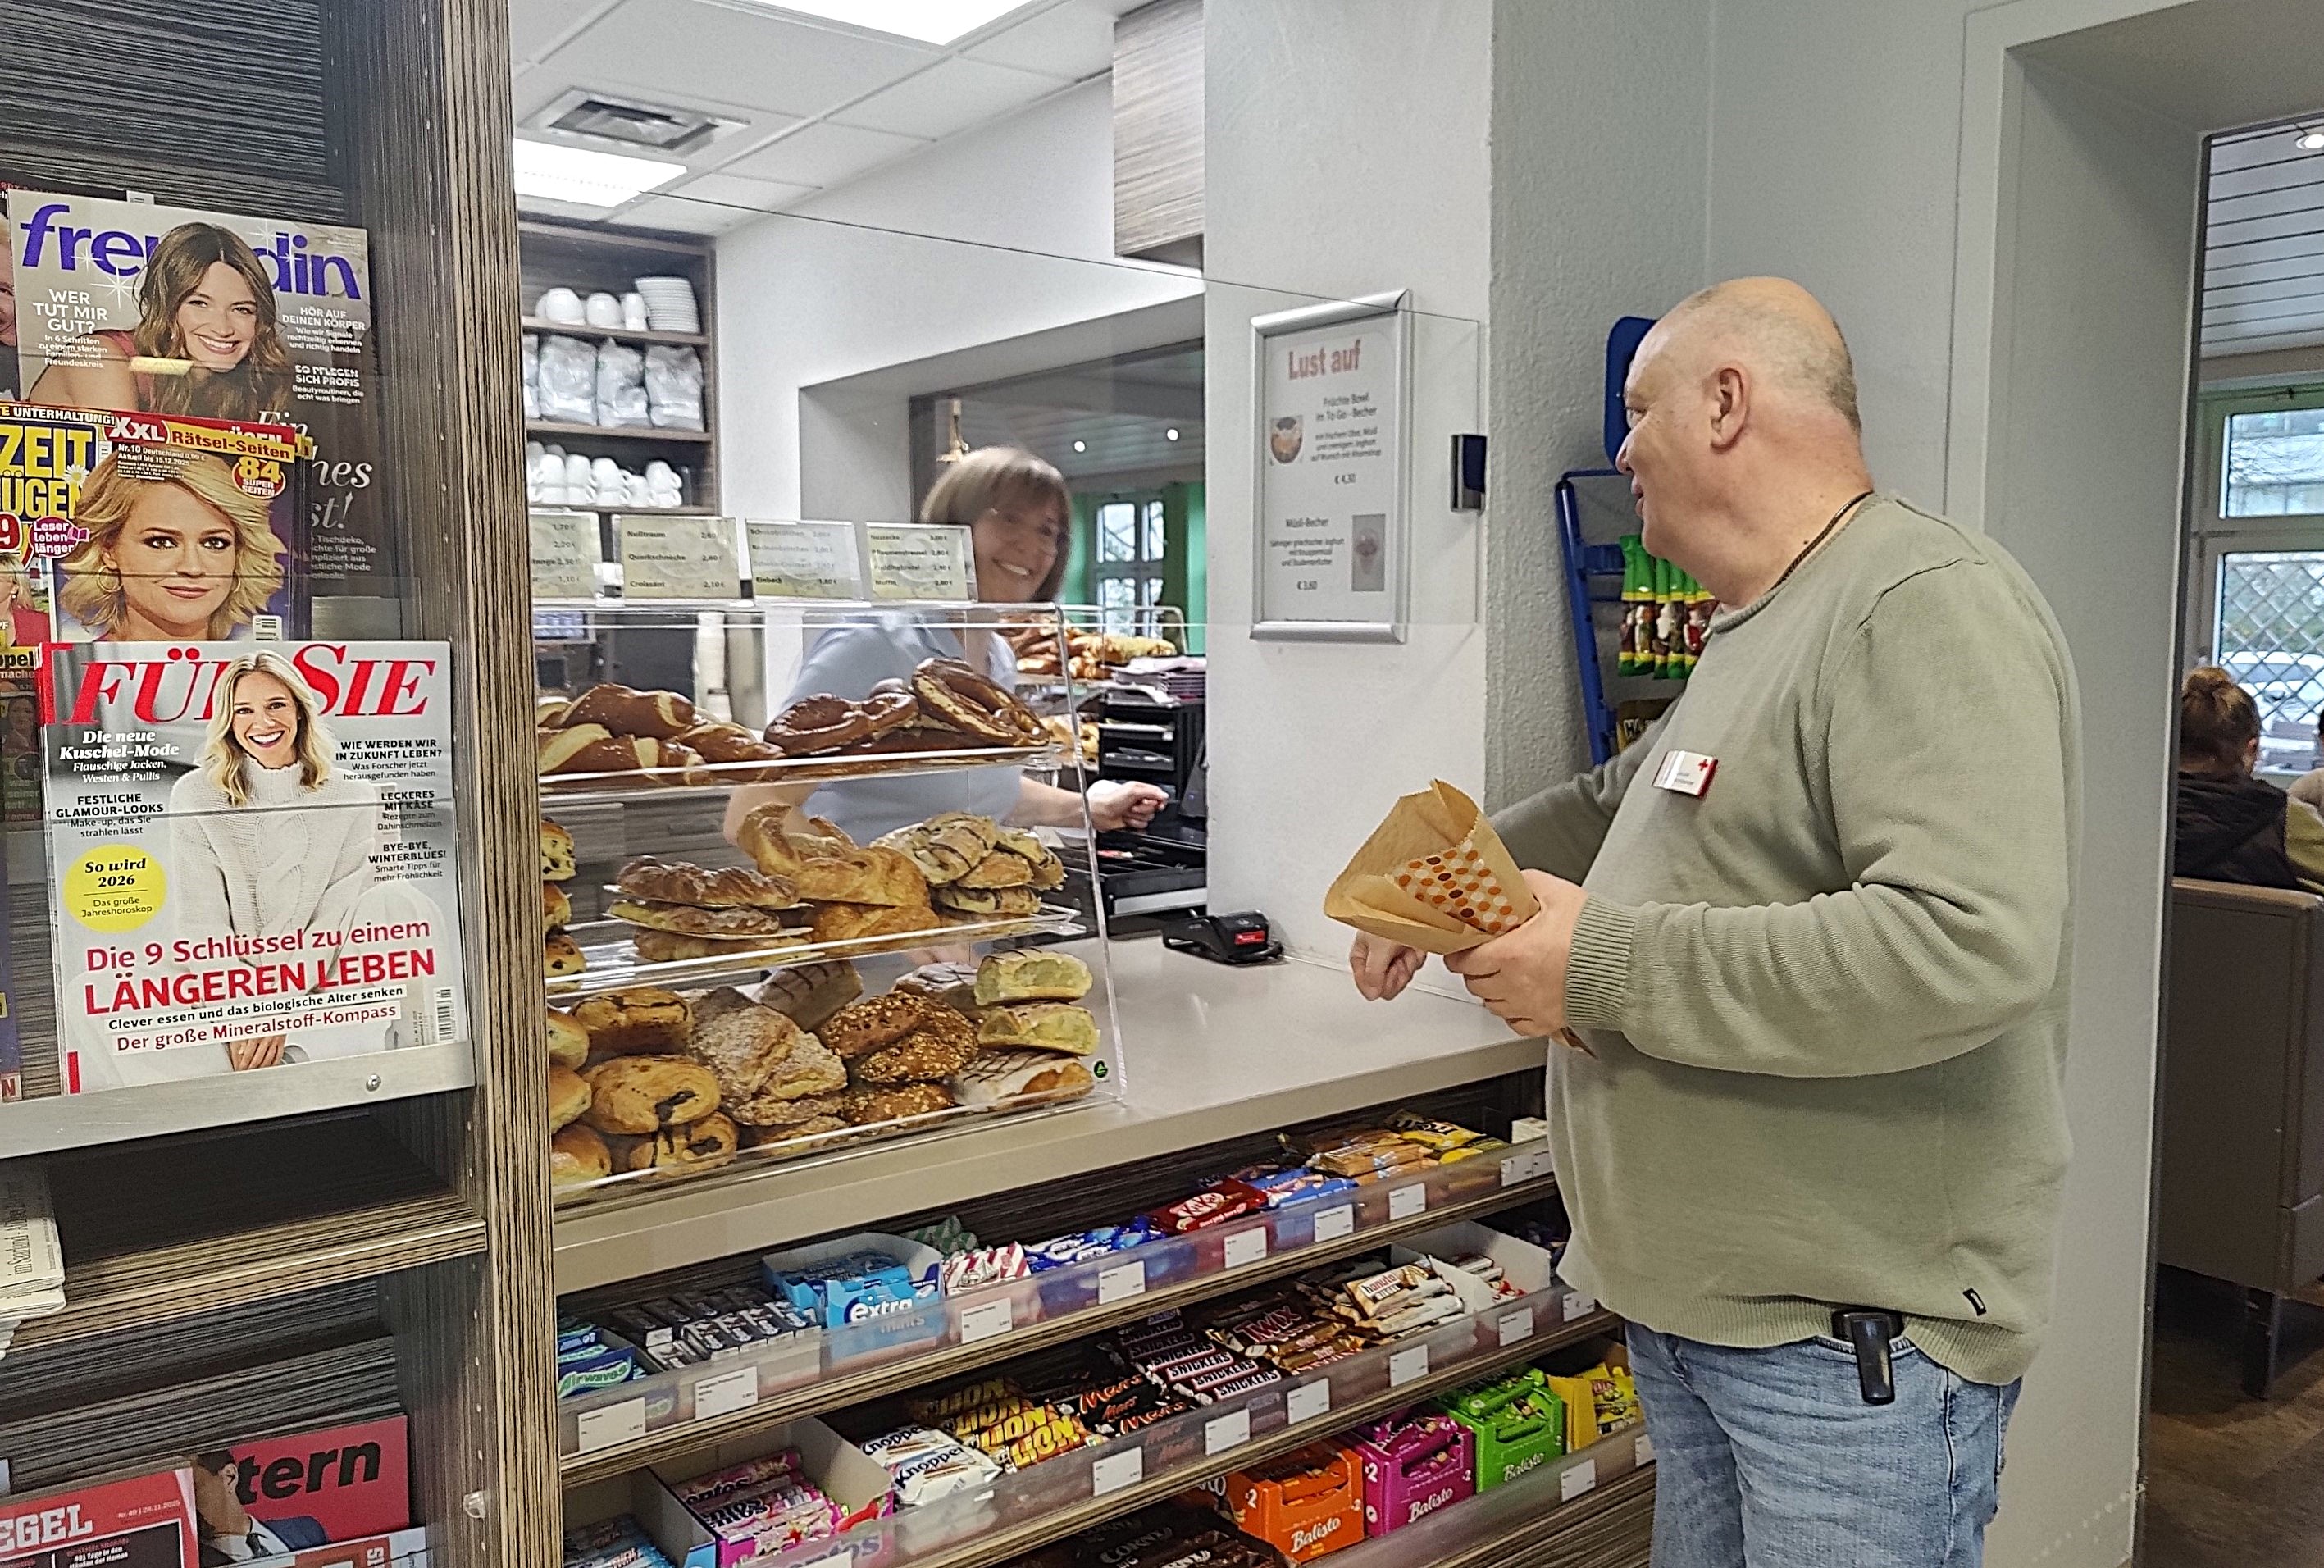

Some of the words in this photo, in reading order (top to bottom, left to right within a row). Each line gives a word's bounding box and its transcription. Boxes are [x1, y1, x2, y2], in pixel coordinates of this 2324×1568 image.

[20, 204, 362, 299] fredin
[49, 289, 90, 305] WER
[33, 302, 68, 317] TUT
[74, 306, 107, 321] MIR
[300, 307, 324, 317] HÖR
[326, 309, 347, 319] AUF
[48, 318, 96, 335] GUT?
[282, 315, 321, 326] DEINEN
[324, 317, 366, 331] KÖRPER
[63, 335, 100, 345] Schritten
[287, 334, 326, 344] rechtzeitig
[328, 339, 362, 347] erkennen
[326, 329, 353, 340] Signale
[50, 344, 76, 352] einem
[77, 345, 107, 353] starken
[330, 344, 361, 354] handeln
[44, 358, 103, 368] Freundeskreis
[1288, 346, 1326, 381] Lust
[1331, 338, 1361, 374] auf
[296, 375, 321, 385] SICH
[323, 376, 360, 388] PROFIS
[332, 394, 360, 405] bringen
[13, 407, 115, 426] UNTERHALTUNG!
[109, 417, 165, 442] XXL
[171, 431, 290, 460] Rätsel-Seiten
[0, 425, 93, 479] ZEIT
[118, 452, 142, 462] Aktuell
[144, 454, 154, 463] bis
[143, 446, 184, 458] Deutschland
[238, 455, 281, 484] 84
[241, 485, 275, 496] SEITEN
[243, 479, 275, 489] SUPER
[34, 521, 69, 532] Leser
[34, 531, 68, 543] leben
[630, 580, 665, 588] Croissant
[293, 643, 437, 717] SIE
[83, 730, 112, 745] Die
[116, 731, 156, 743] neue
[340, 741, 362, 750] WIE
[365, 740, 412, 750] WERDEN
[415, 739, 437, 748] WIR
[60, 743, 180, 760] Kuschel-Mode
[336, 751, 347, 761] IN
[349, 750, 402, 761] ZUKUNFT
[403, 748, 442, 759] LEBEN?
[73, 760, 128, 773] Flauschige
[130, 759, 167, 771] Jacken,
[352, 761, 370, 771] Was
[372, 761, 407, 771] Forscher
[408, 760, 427, 772] jetzt
[83, 773, 120, 784] Westen
[121, 773, 130, 782] &
[133, 771, 161, 782] Pullis
[344, 771, 409, 782] herausgefunden
[411, 768, 435, 778] haben
[78, 793, 142, 805] FESTLICHE
[380, 790, 435, 801] LECKERES
[56, 804, 164, 818] GLAMOUR-LOOKS
[385, 801, 403, 812] MIT
[405, 799, 434, 811] KÄSE
[71, 817, 117, 828] Make-up,
[118, 817, 134, 826] das
[136, 815, 151, 824] Sie
[417, 811, 436, 820] zum
[80, 827, 120, 838] strahlen
[121, 826, 144, 836] lässt
[382, 841, 432, 853] BYE-BYE,
[368, 850, 447, 864] WINTERBLUES!
[84, 860, 105, 873] So
[108, 858, 147, 872] wird
[375, 863, 405, 873] Smarte
[407, 862, 427, 873] Tipps
[429, 861, 441, 871] für
[98, 875, 135, 888] 2026
[374, 873, 396, 883] mehr
[397, 869, 444, 882] Fröhlichkeit
[93, 898, 112, 908] Das
[113, 896, 140, 908] große
[81, 905, 153, 918] Jahreshoroskop
[87, 946, 136, 972] Die
[145, 943, 163, 965] 9
[174, 928, 304, 964] Schlüssel
[312, 930, 342, 949] zu
[351, 922, 431, 944] einem
[84, 961, 306, 1016] LÄNGEREN
[317, 948, 436, 989] LEBEN
[108, 1016, 153, 1030] Clever
[157, 1012, 195, 1025] essen
[199, 1007, 223, 1020] und
[227, 1005, 249, 1017] das
[253, 995, 323, 1013] biologische
[328, 991, 358, 1004] Alter
[361, 987, 403, 1000] senken
[117, 1035, 150, 1051] Der
[155, 1028, 207, 1050] große
[213, 1005, 397, 1041] Mineralstoff-Kompass
[850, 1298, 913, 1322] extra
[1153, 1341, 1214, 1365] SNICKERS
[1170, 1352, 1232, 1378] SNICKERS
[1195, 1360, 1256, 1386] SNICKERS
[1217, 1370, 1278, 1396] SNICKERS
[1079, 1374, 1143, 1415] Mars
[1119, 1401, 1187, 1434] Mars
[235, 1441, 381, 1506] tern
[1503, 1452, 1545, 1482] Balisto
[1407, 1488, 1454, 1523] Balisto
[1290, 1516, 1342, 1553] Balisto
